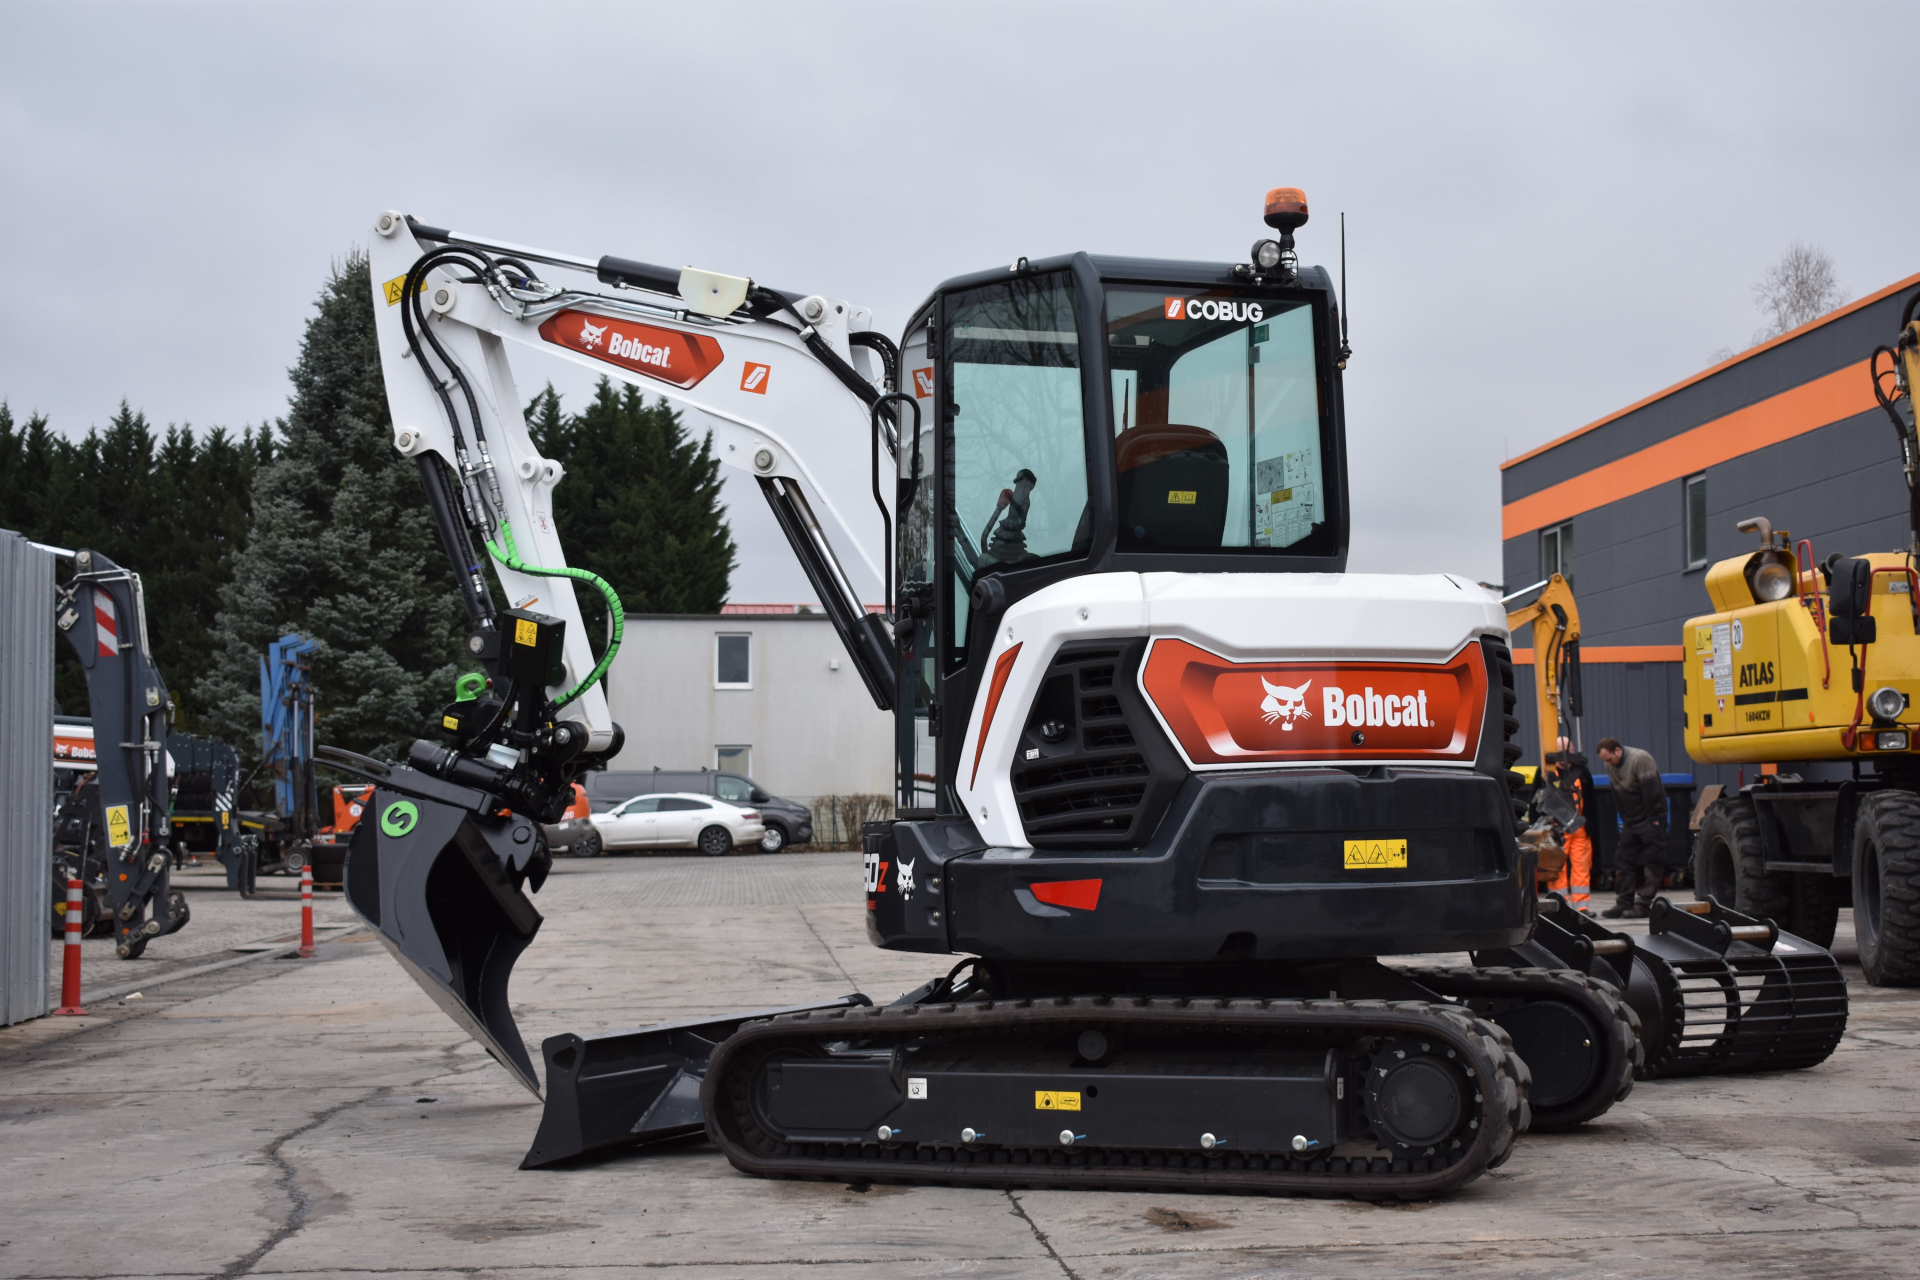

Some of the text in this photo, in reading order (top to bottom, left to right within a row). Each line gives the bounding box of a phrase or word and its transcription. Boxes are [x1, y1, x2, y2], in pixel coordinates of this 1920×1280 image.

[1186, 299, 1263, 323] COBUG
[608, 332, 671, 368] Bobcat
[1733, 625, 1741, 645] 20
[1739, 661, 1775, 688] ATLAS
[1322, 686, 1429, 728] Bobcat
